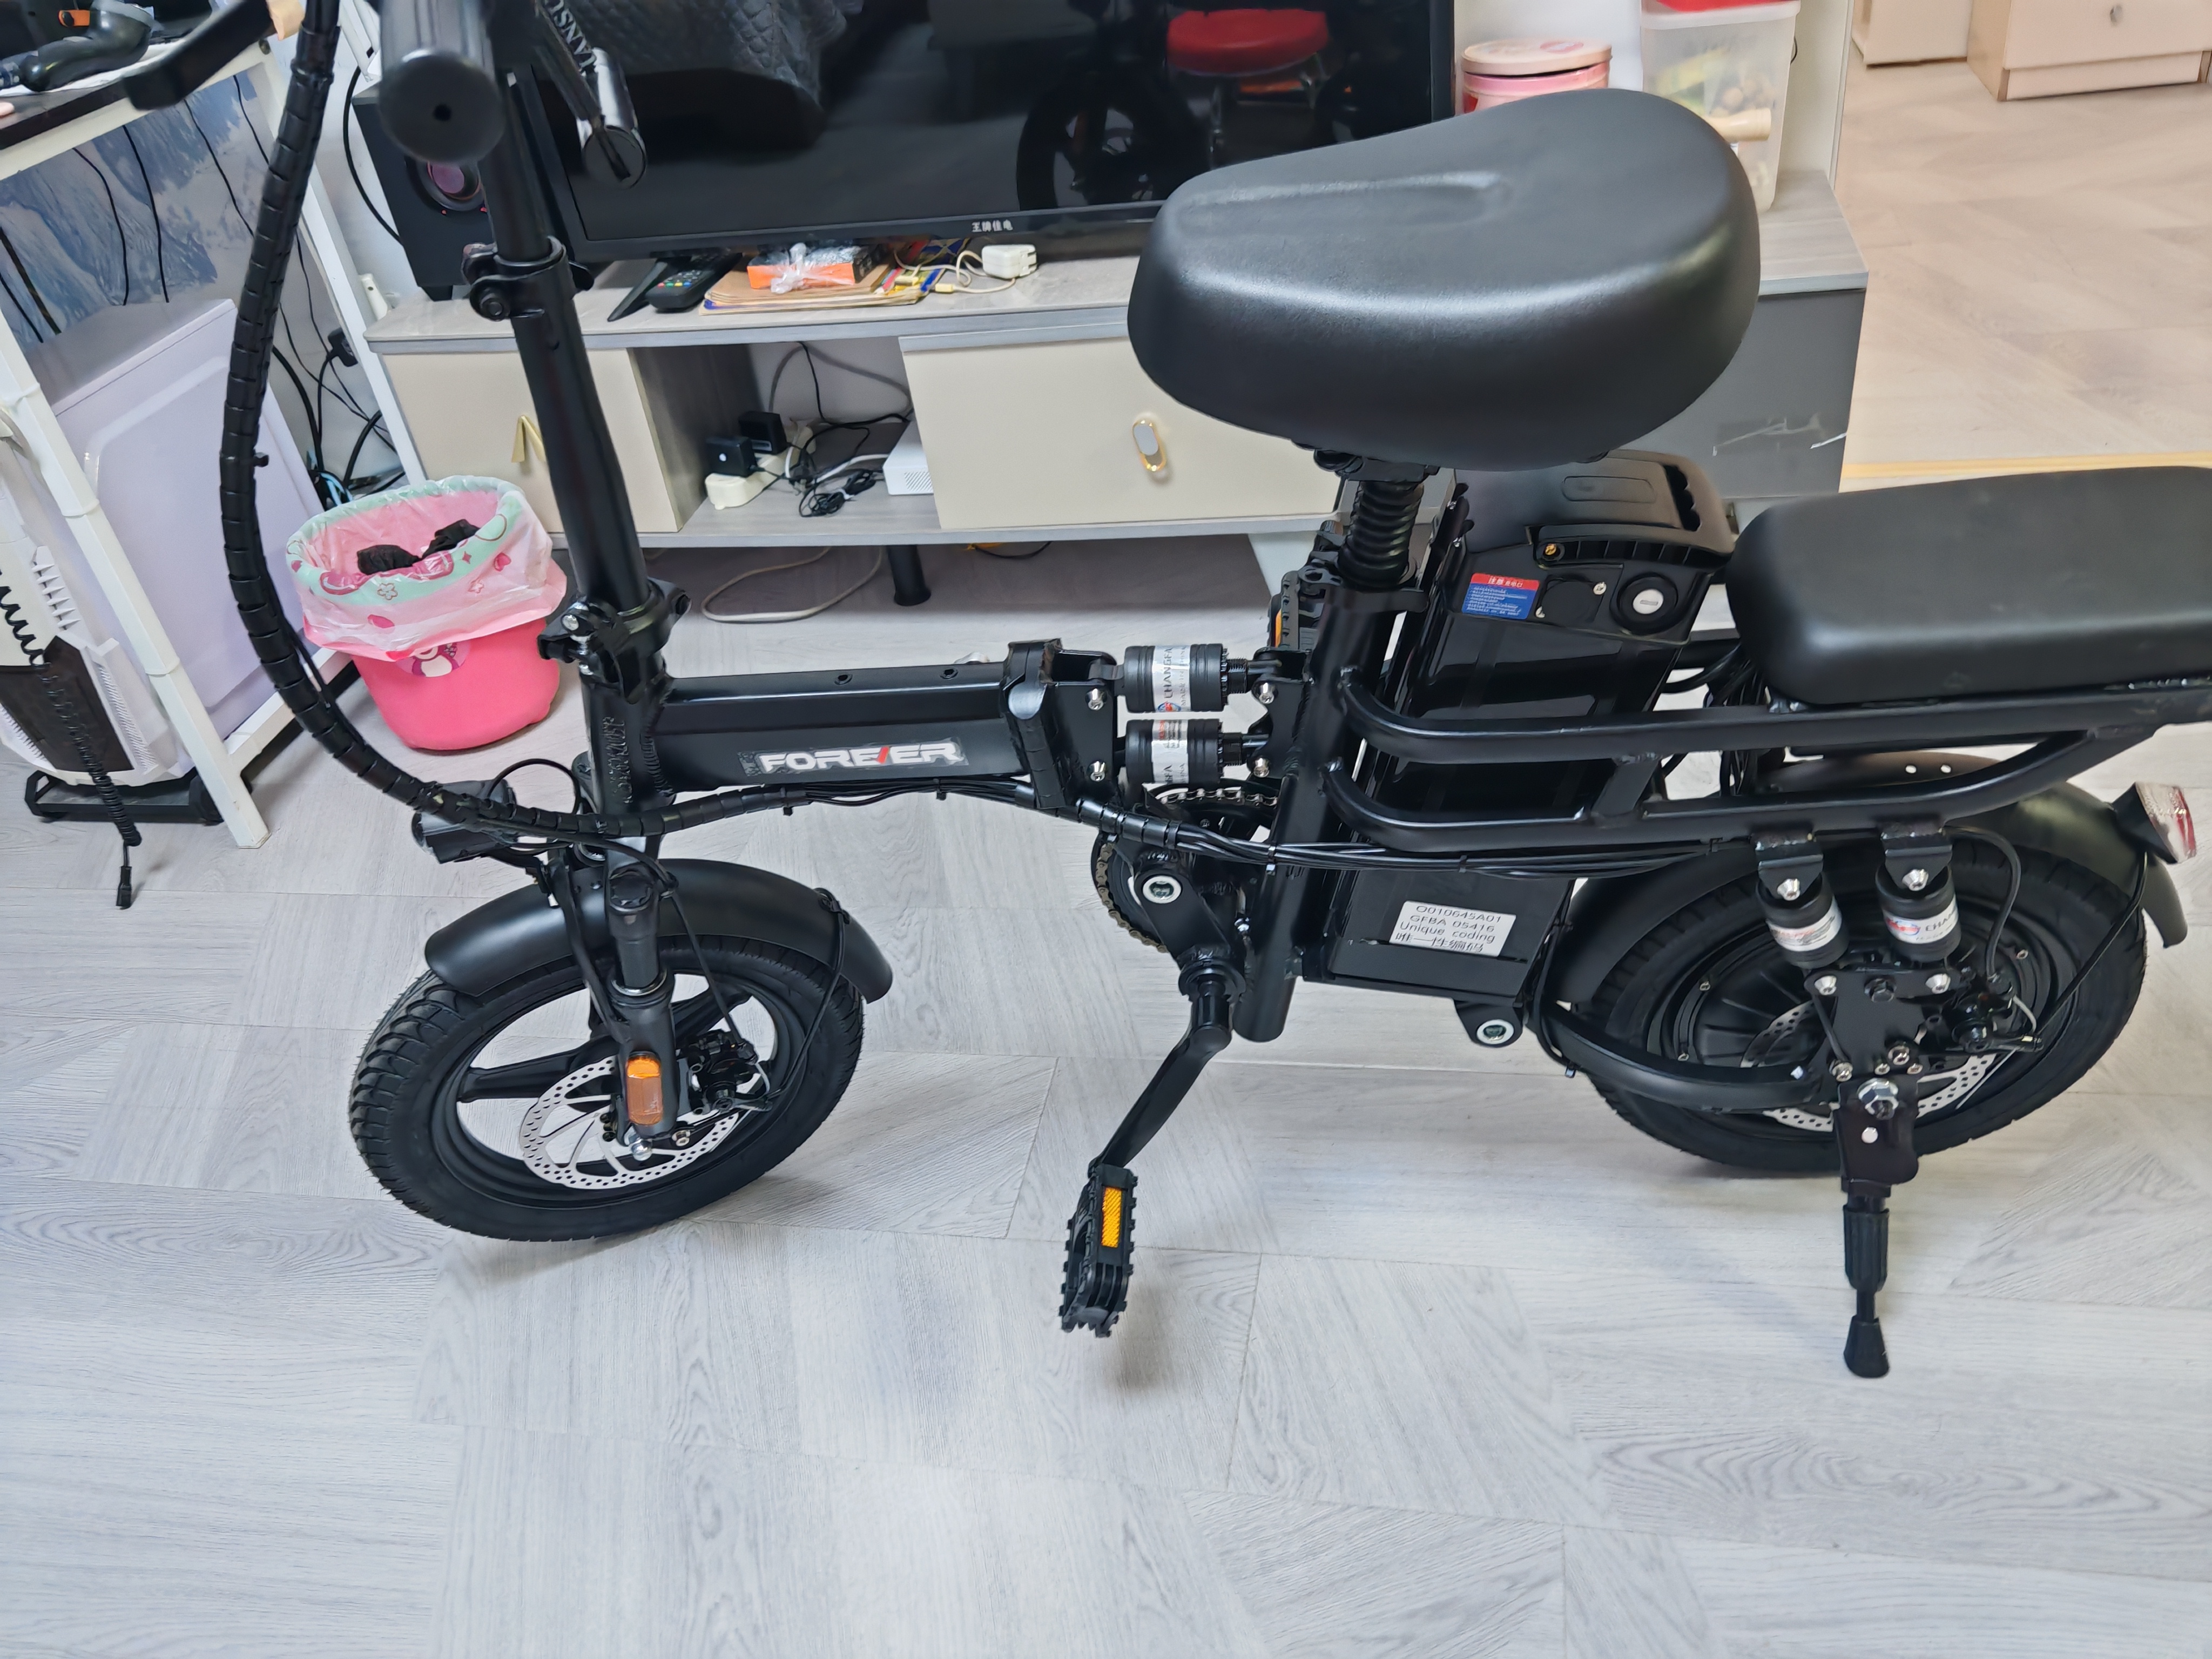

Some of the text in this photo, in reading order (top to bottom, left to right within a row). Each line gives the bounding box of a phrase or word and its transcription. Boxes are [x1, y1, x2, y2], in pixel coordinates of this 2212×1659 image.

[758, 743, 963, 773] FOREVER
[1395, 932, 1485, 953] 唯一性编码
[1400, 921, 1495, 944] Unique coding
